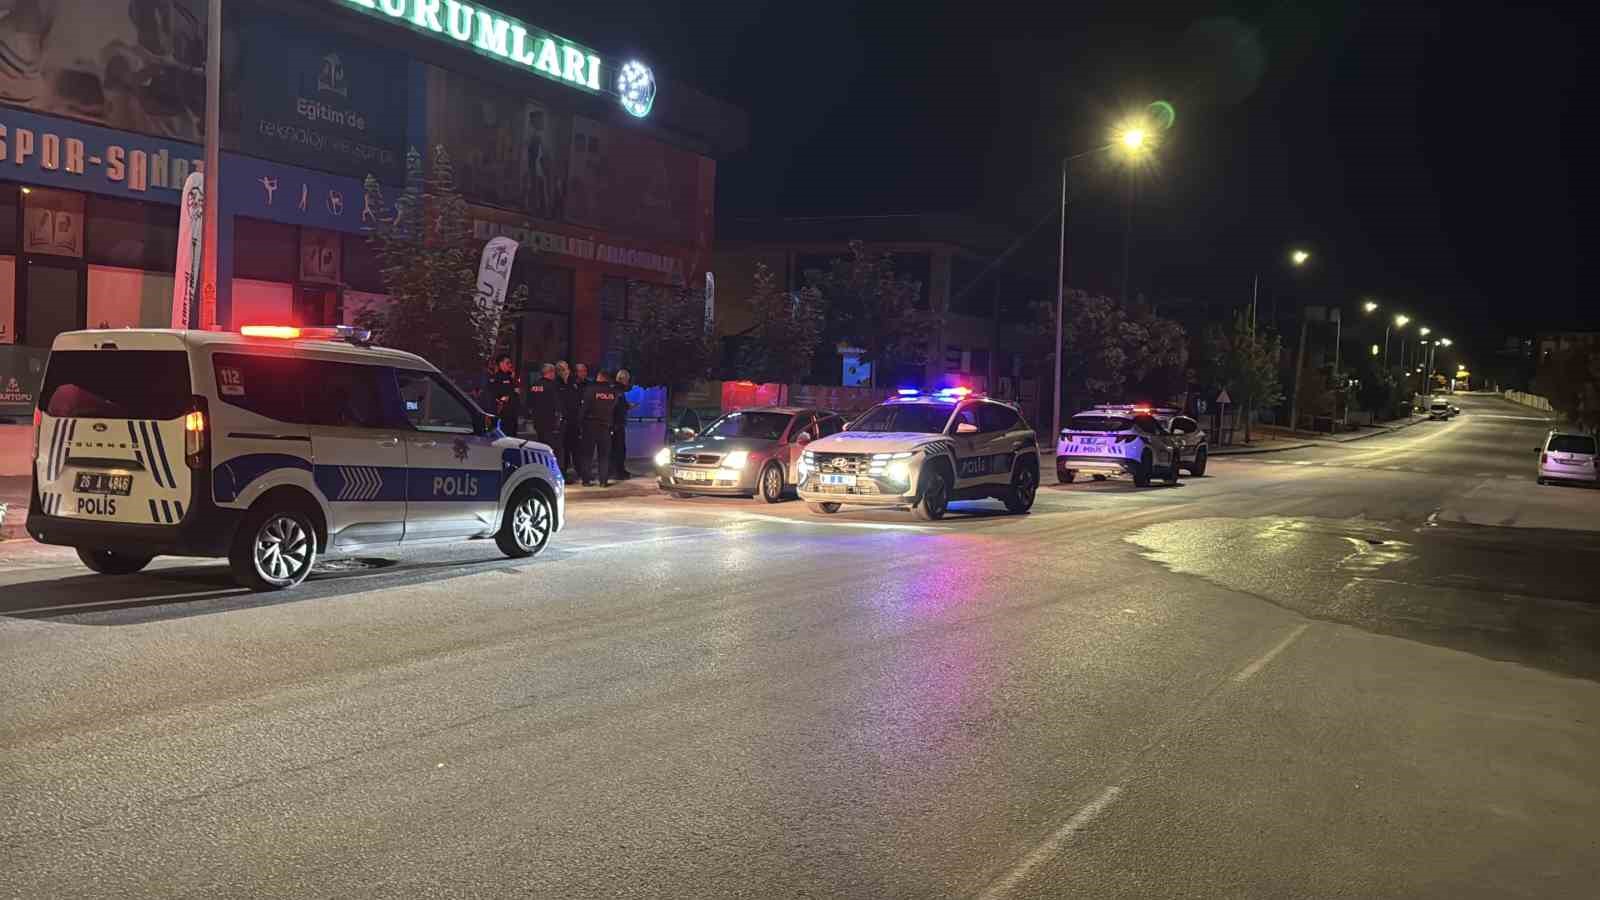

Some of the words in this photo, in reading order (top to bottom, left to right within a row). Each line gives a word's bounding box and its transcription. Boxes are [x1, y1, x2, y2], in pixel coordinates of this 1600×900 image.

[221, 368, 240, 384] 112
[432, 472, 479, 496] POLİS
[78, 494, 117, 516] POLİS
